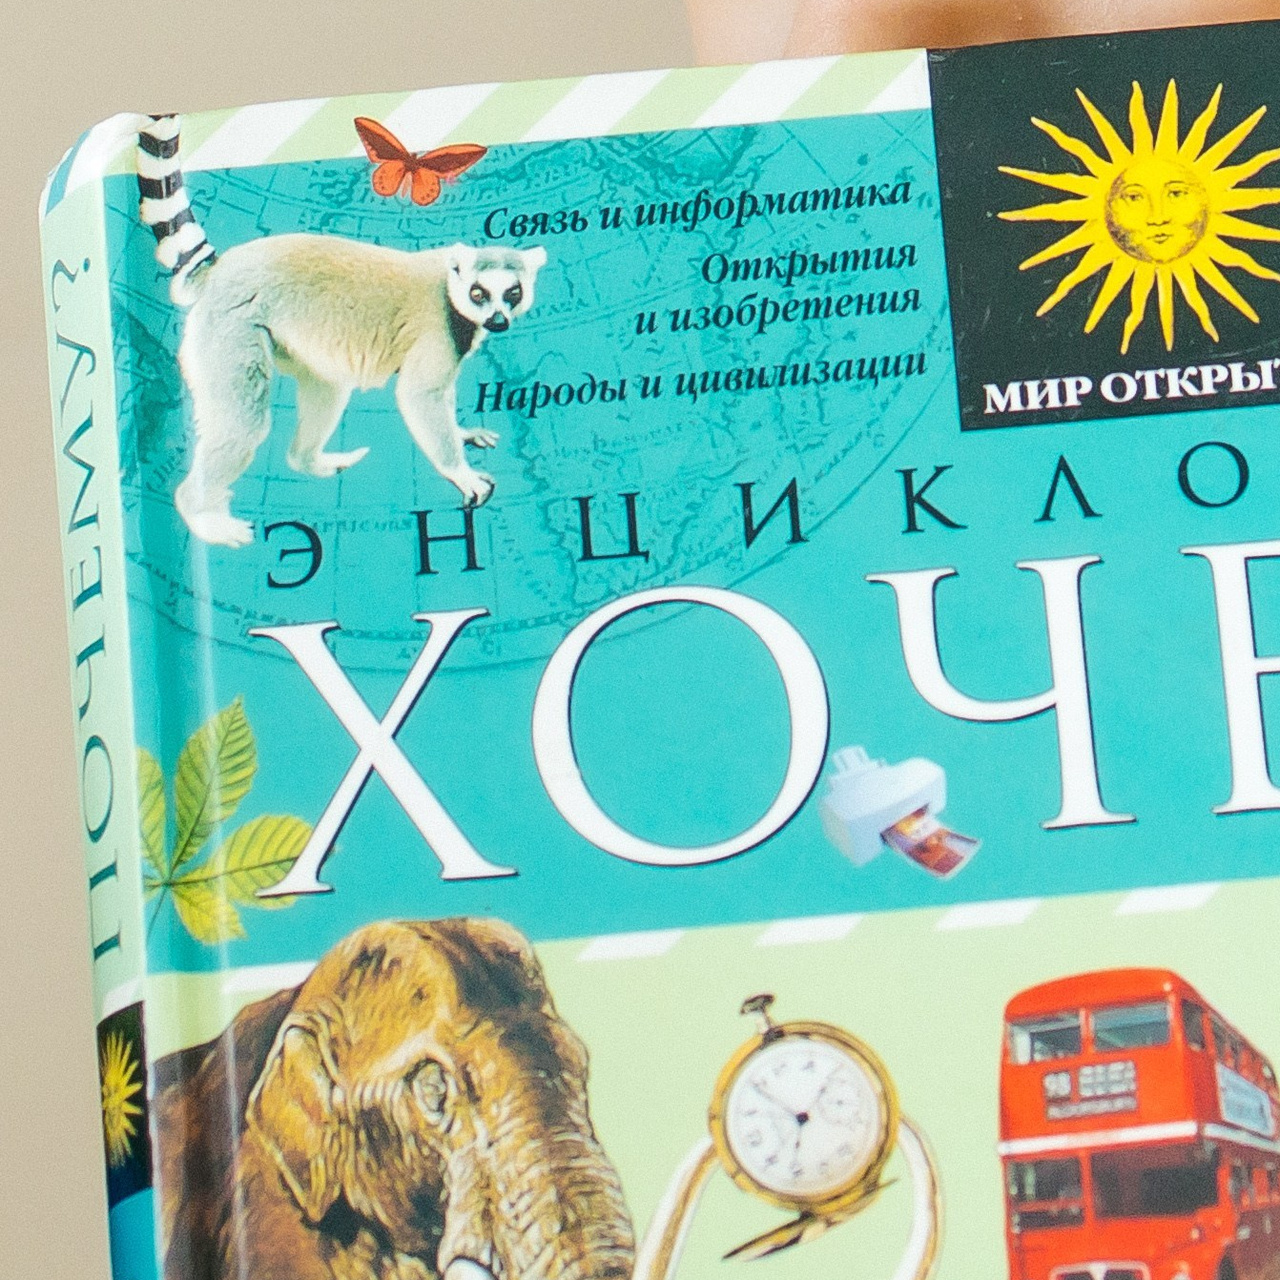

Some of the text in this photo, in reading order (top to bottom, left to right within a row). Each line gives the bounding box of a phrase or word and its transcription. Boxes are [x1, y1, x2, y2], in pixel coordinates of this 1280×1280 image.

[483, 180, 913, 240] Связь и информатика
[701, 243, 918, 287] Открытия
[635, 286, 921, 335] и изобретения
[473, 349, 928, 419] Народы и цивилизации
[982, 375, 1094, 415] МИР
[51, 256, 122, 968] ПОЧЕМУ?
